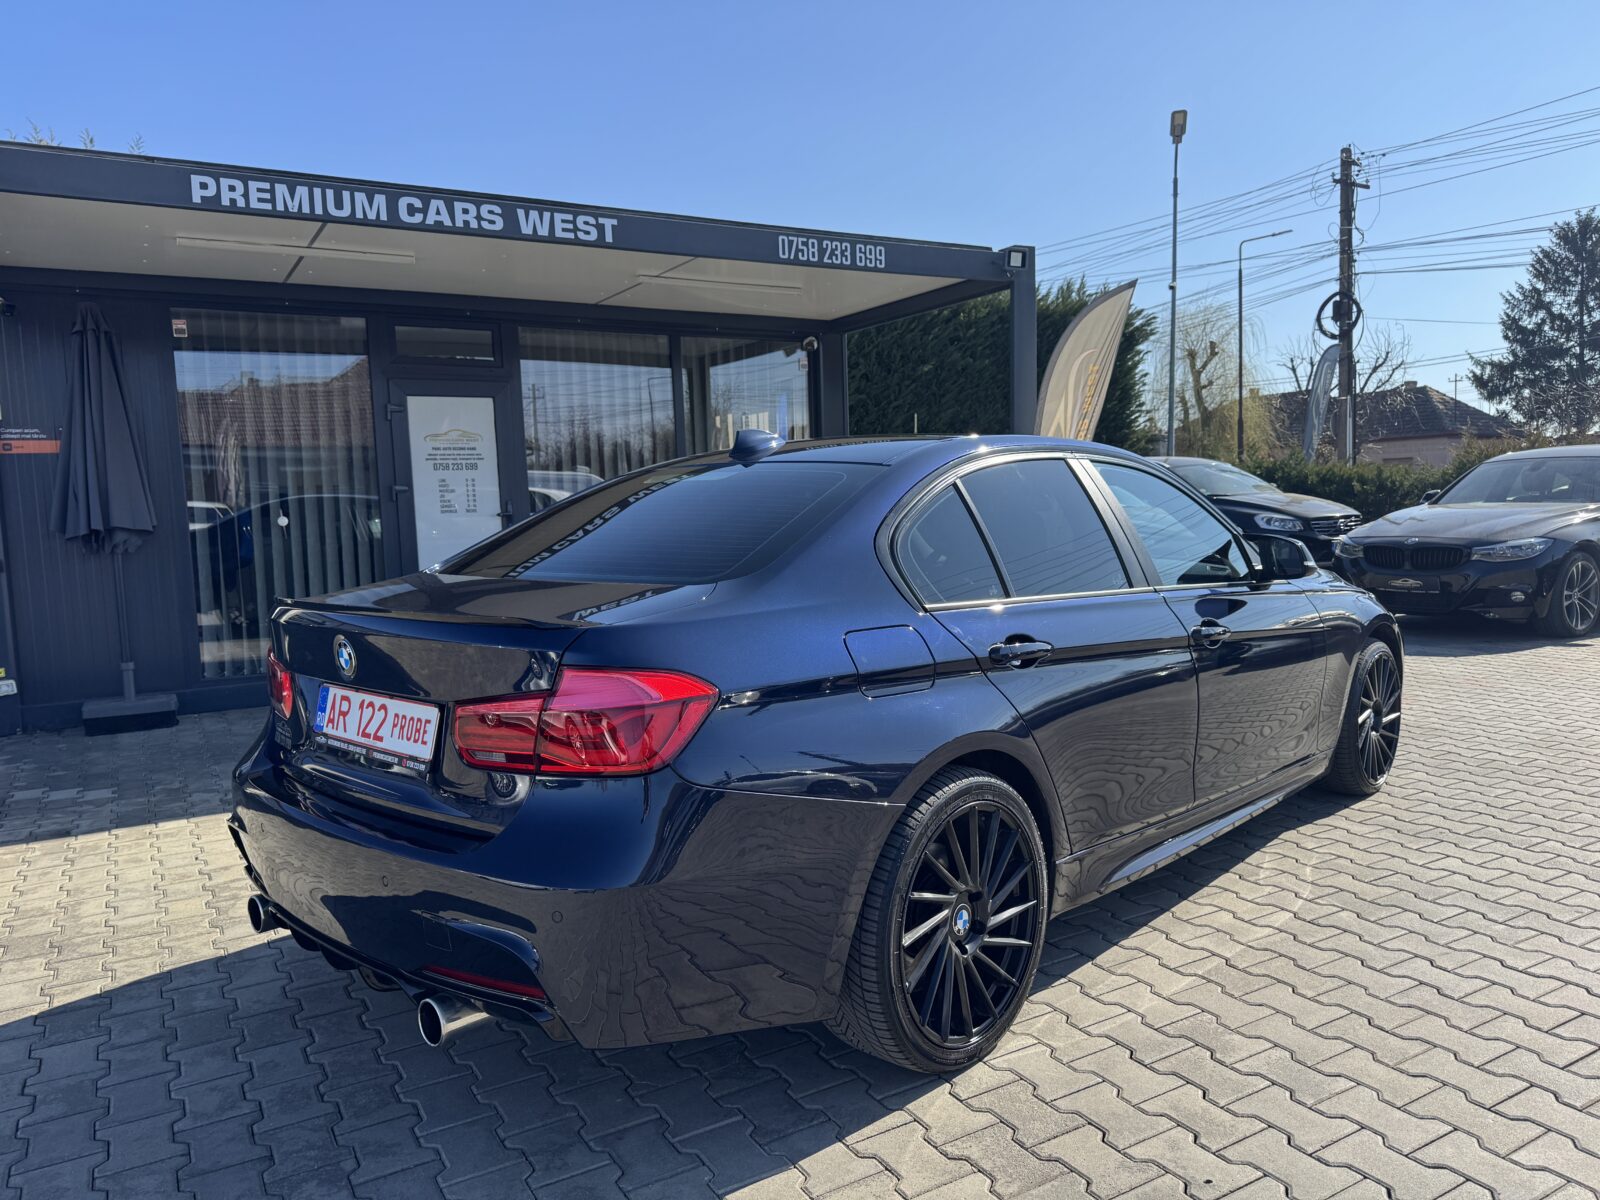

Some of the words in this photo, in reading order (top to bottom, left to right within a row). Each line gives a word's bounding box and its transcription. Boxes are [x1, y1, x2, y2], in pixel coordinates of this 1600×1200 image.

[190, 174, 387, 221] PREMIUM
[398, 196, 504, 231] CARS
[516, 208, 618, 243] WEST
[778, 235, 818, 262] 0758
[822, 240, 851, 265] 233
[856, 244, 885, 268] 699
[433, 462, 450, 471] 0758
[451, 462, 464, 471] 233
[465, 462, 479, 471] 699
[326, 692, 352, 733] AR
[357, 699, 388, 742] 122
[391, 713, 431, 745] PROBE
